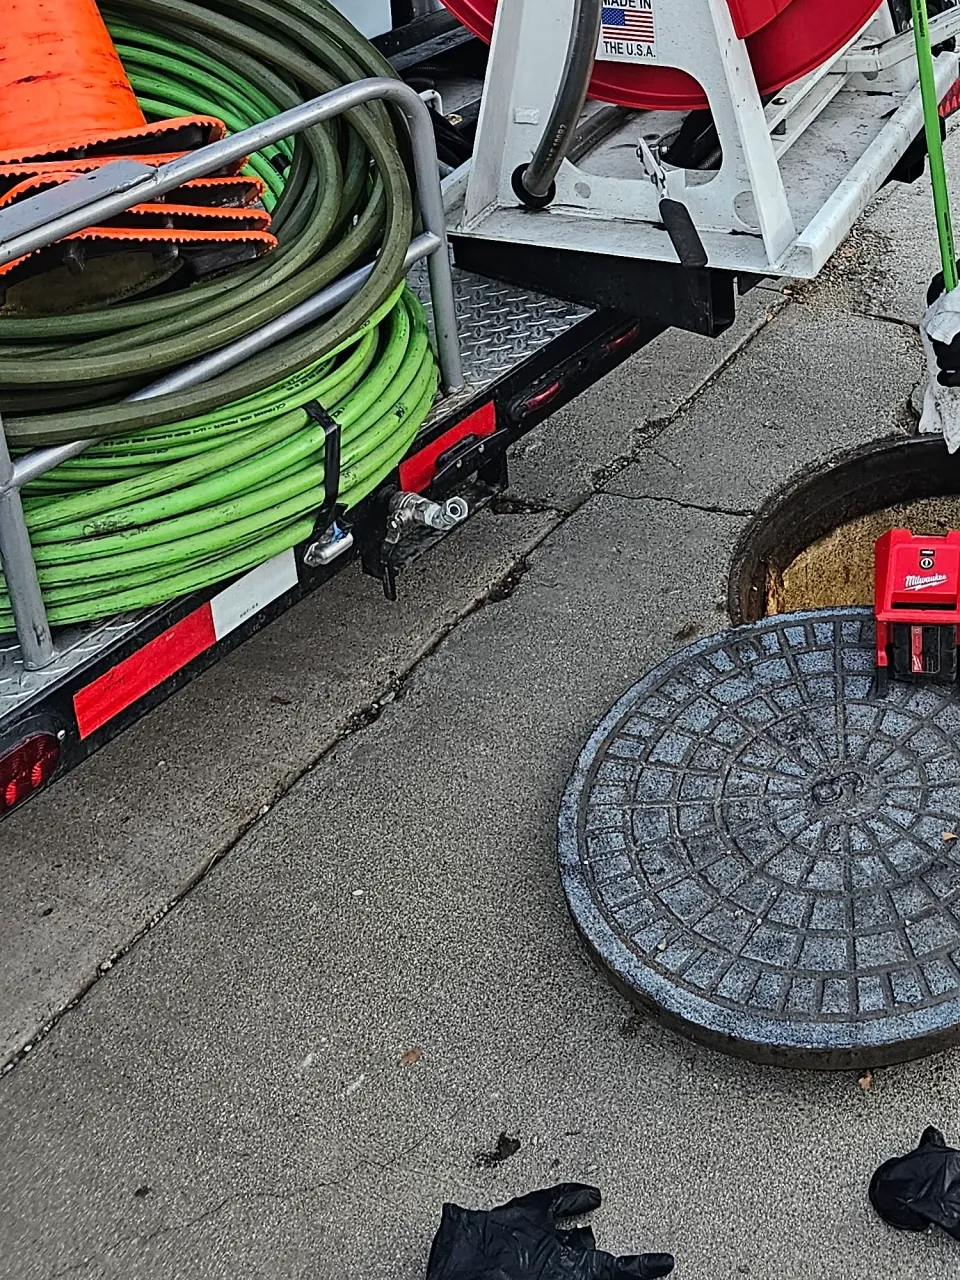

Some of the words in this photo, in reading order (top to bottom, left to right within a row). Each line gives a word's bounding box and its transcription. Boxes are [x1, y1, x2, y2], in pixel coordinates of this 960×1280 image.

[603, 40, 624, 55] THE
[626, 42, 656, 58] U.S.A.
[904, 573, 947, 588] Milwaukee
